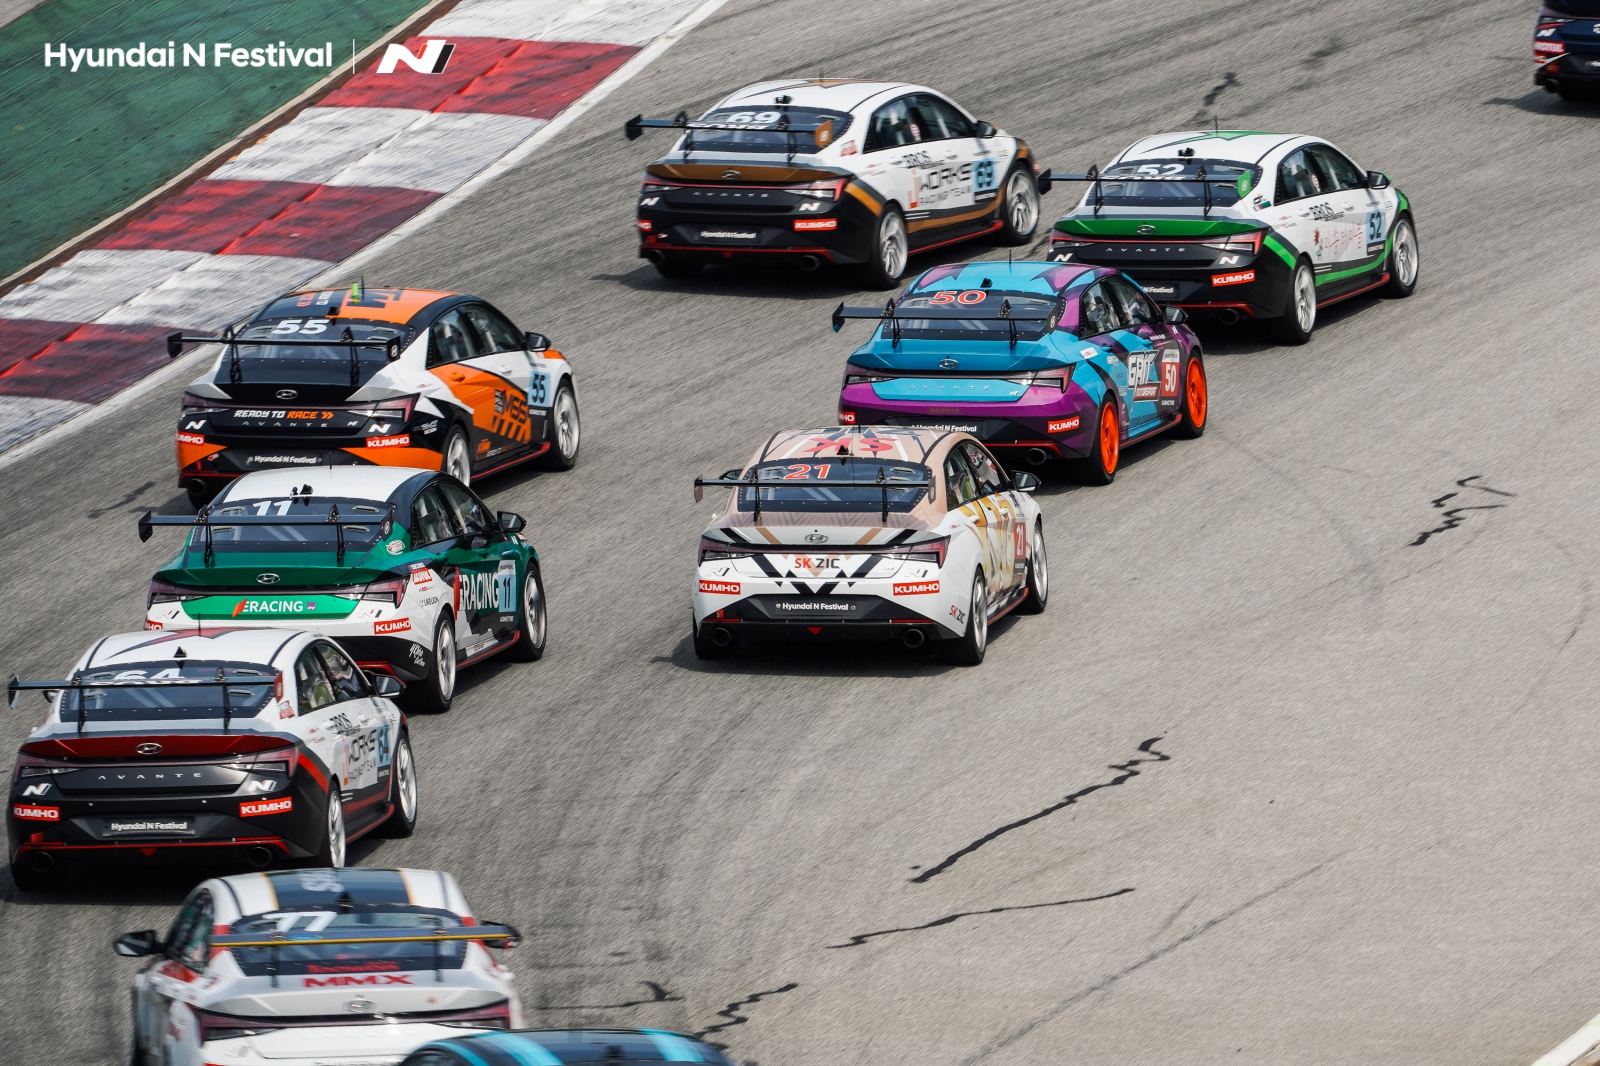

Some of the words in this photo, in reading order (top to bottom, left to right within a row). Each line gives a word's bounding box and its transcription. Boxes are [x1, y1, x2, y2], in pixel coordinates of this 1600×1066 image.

[726, 111, 781, 124] 69
[1137, 164, 1185, 176] 52
[1369, 211, 1382, 240] 52
[1212, 272, 1255, 285] KUMHO
[929, 290, 987, 305] 50
[271, 319, 329, 334] 55
[1165, 363, 1177, 393] 50
[532, 373, 546, 403] 55
[234, 410, 271, 418] READY
[286, 411, 318, 419] RACE
[951, 425, 977, 433] Festival
[1049, 419, 1080, 431] KUMHO
[367, 436, 410, 448] KUMHO
[783, 464, 831, 479] 21
[253, 501, 293, 516] 11
[1016, 524, 1025, 556] 21
[794, 557, 812, 568] SK
[815, 558, 840, 568] ZIC
[503, 578, 511, 609] 11
[699, 582, 740, 593] KUMHO
[894, 583, 939, 593] KUMHO
[782, 602, 813, 611] Hyundai
[820, 602, 849, 611] Festival
[375, 620, 411, 633] KUMHO
[14, 808, 59, 819] KUMHO
[241, 800, 292, 814] KUMHO
[111, 822, 146, 833] Hyundai
[154, 822, 188, 831] Festival
[263, 911, 337, 932] 77
[302, 974, 416, 988] MMX
